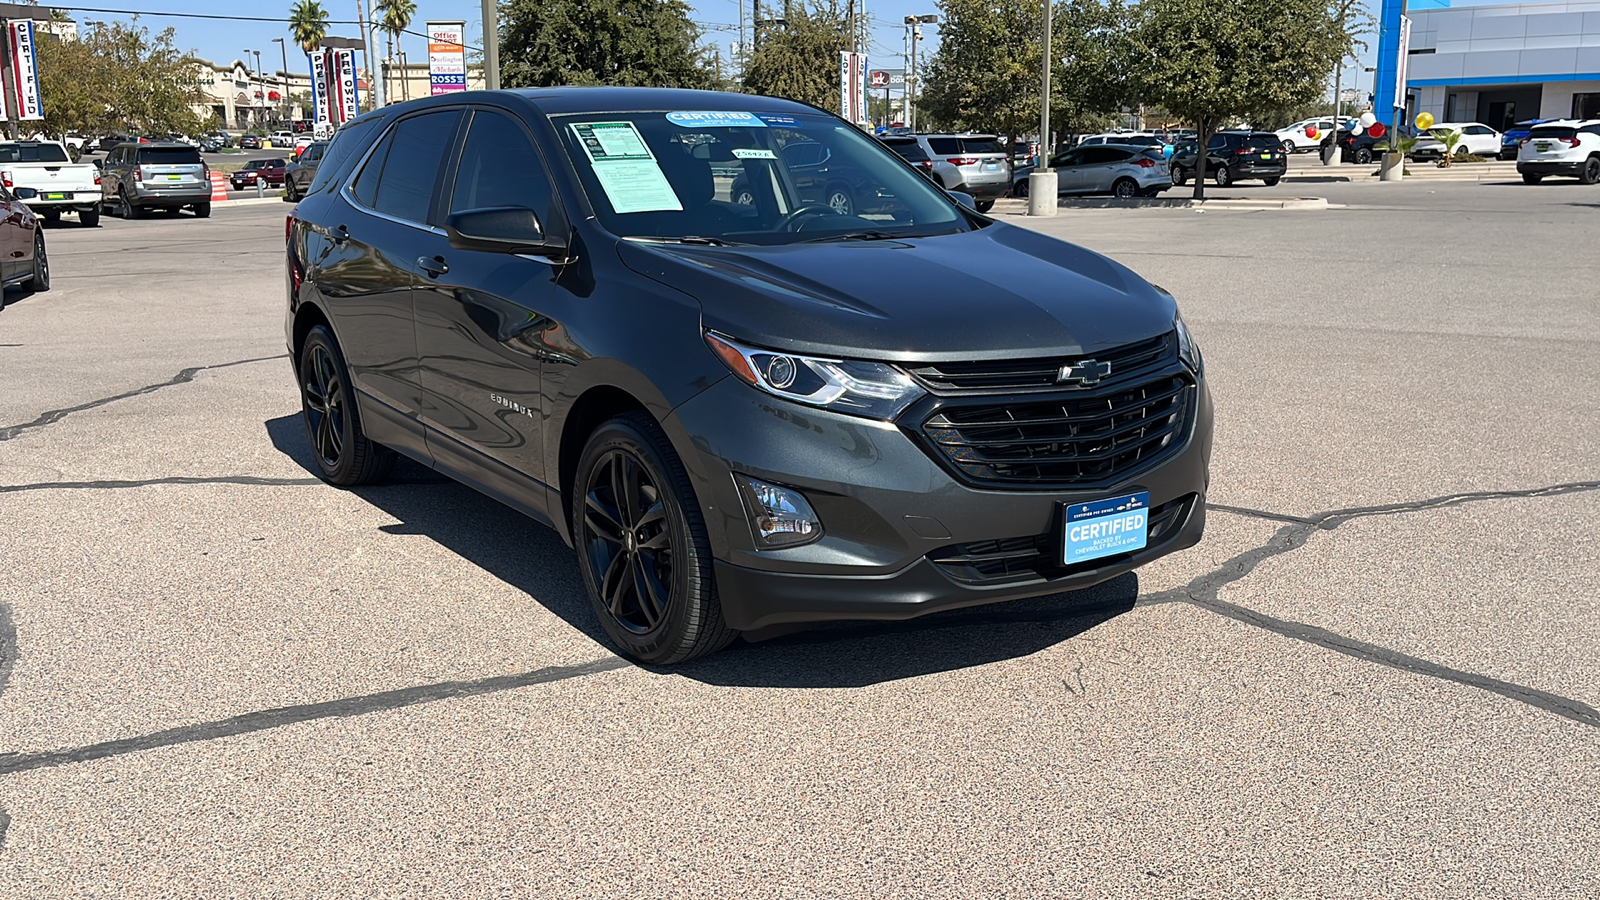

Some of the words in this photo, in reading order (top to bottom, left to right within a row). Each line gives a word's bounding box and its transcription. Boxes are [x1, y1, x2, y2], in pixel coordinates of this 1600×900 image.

[17, 24, 36, 114] CERTIFIED
[314, 55, 324, 78] PRE
[340, 52, 352, 75] PRE
[432, 75, 457, 83] ROSS
[890, 76, 905, 84] box
[317, 82, 327, 122] OWNED
[670, 112, 753, 121] CERTIFIED
[315, 130, 327, 138] 40
[490, 393, 533, 418] EQUINOX
[1070, 514, 1144, 543] CERTIFIED
[1075, 544, 1106, 555] CHEVROLET
[1106, 540, 1122, 548] BUICK
[1126, 536, 1138, 544] GMC
[1093, 537, 1114, 546] BACKED
